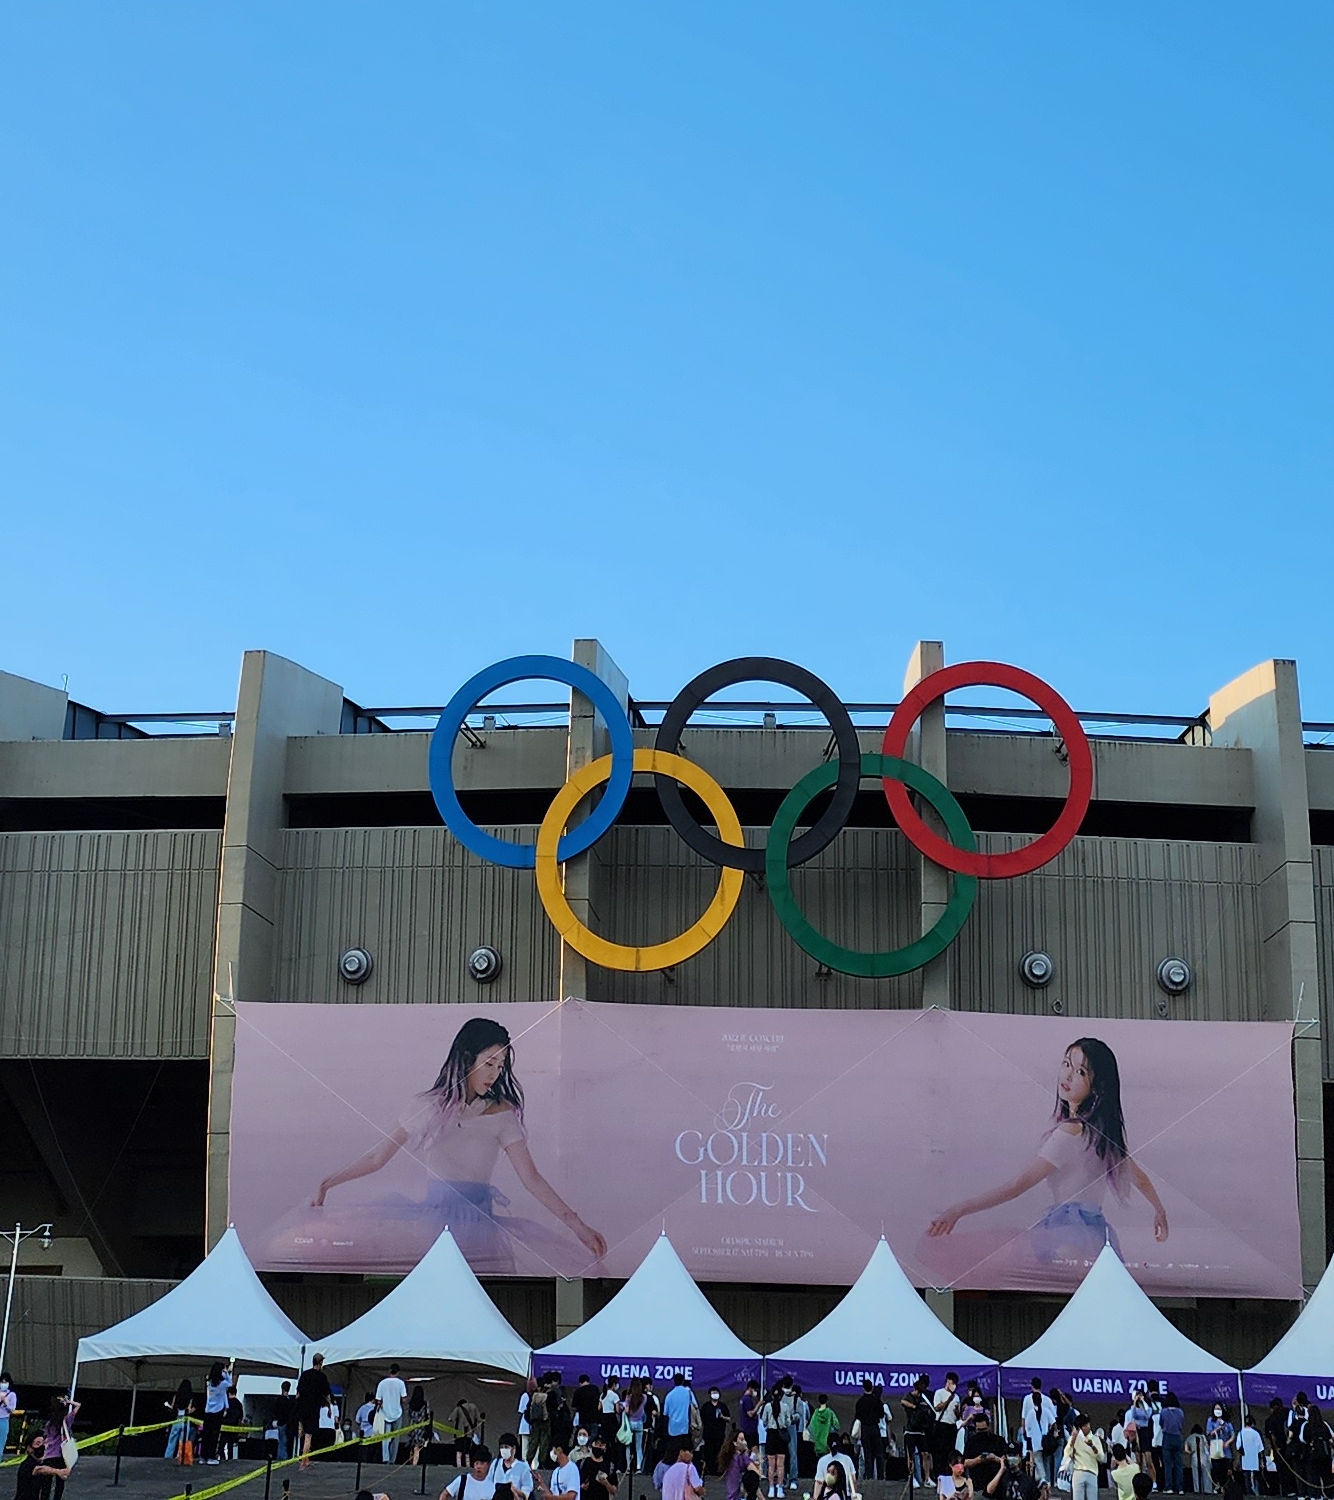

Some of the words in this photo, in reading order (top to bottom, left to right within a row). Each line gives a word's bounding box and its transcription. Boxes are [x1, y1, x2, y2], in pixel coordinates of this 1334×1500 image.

[714, 1080, 782, 1133] The
[674, 1129, 829, 1168] GOLDEN
[699, 1169, 819, 1213] HOUR
[601, 1363, 650, 1379] UAENA
[835, 1370, 886, 1387] UAENA
[889, 1372, 929, 1387] ZON
[1072, 1377, 1124, 1394] UAENA
[1128, 1379, 1168, 1395] ZOE
